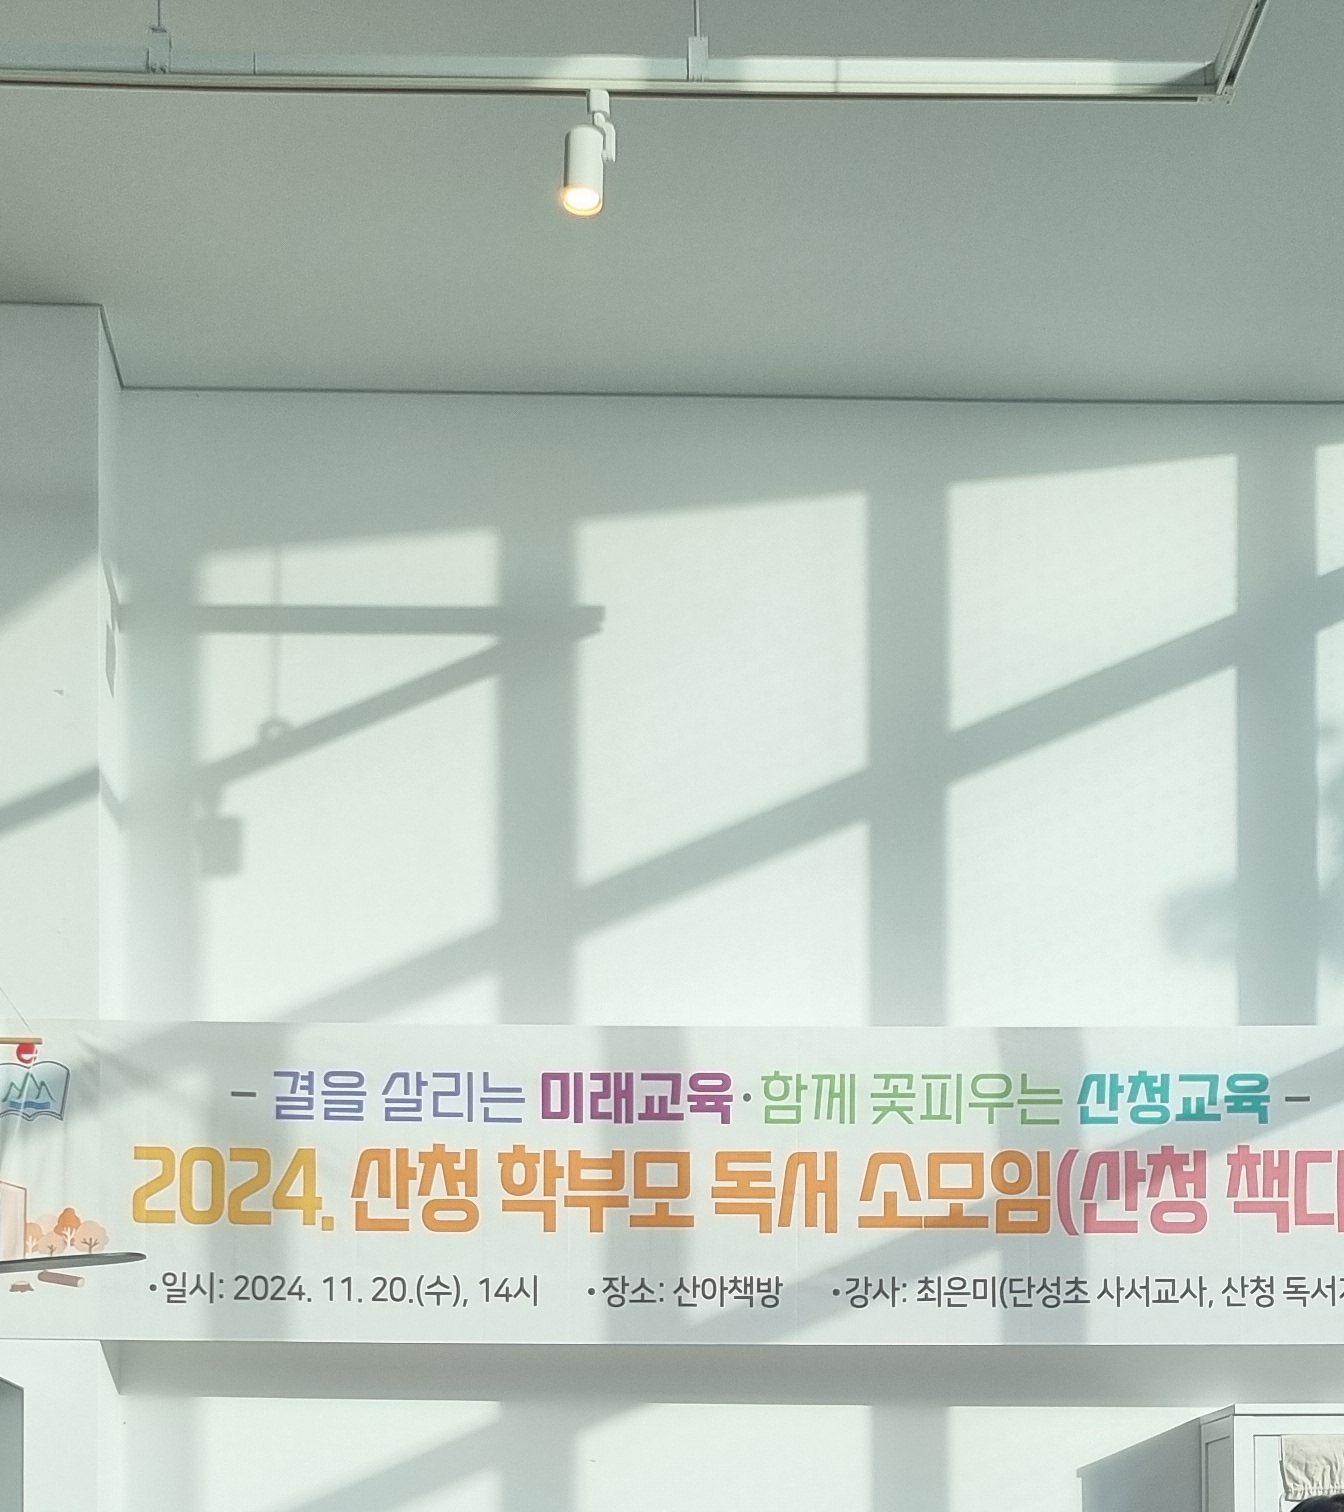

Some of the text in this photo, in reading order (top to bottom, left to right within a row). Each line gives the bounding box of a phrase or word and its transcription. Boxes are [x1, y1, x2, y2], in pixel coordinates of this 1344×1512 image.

[274, 1071, 367, 1121] 결을
[382, 1072, 525, 1123] 살리는
[871, 1074, 1063, 1124] 꽃피우는
[1077, 1070, 1270, 1124] 산청교육
[132, 1146, 334, 1231] 2024.
[351, 1144, 479, 1232] 산청
[498, 1145, 694, 1232] 학부모
[711, 1151, 837, 1233] 독서
[234, 1275, 311, 1302] 2024.
[323, 1276, 362, 1303] 11.
[479, 1275, 537, 1306] 14시
[673, 1276, 783, 1308] 산아책방
[1097, 1276, 1213, 1308] 사서교사,
[1222, 1275, 1274, 1308] 산청
